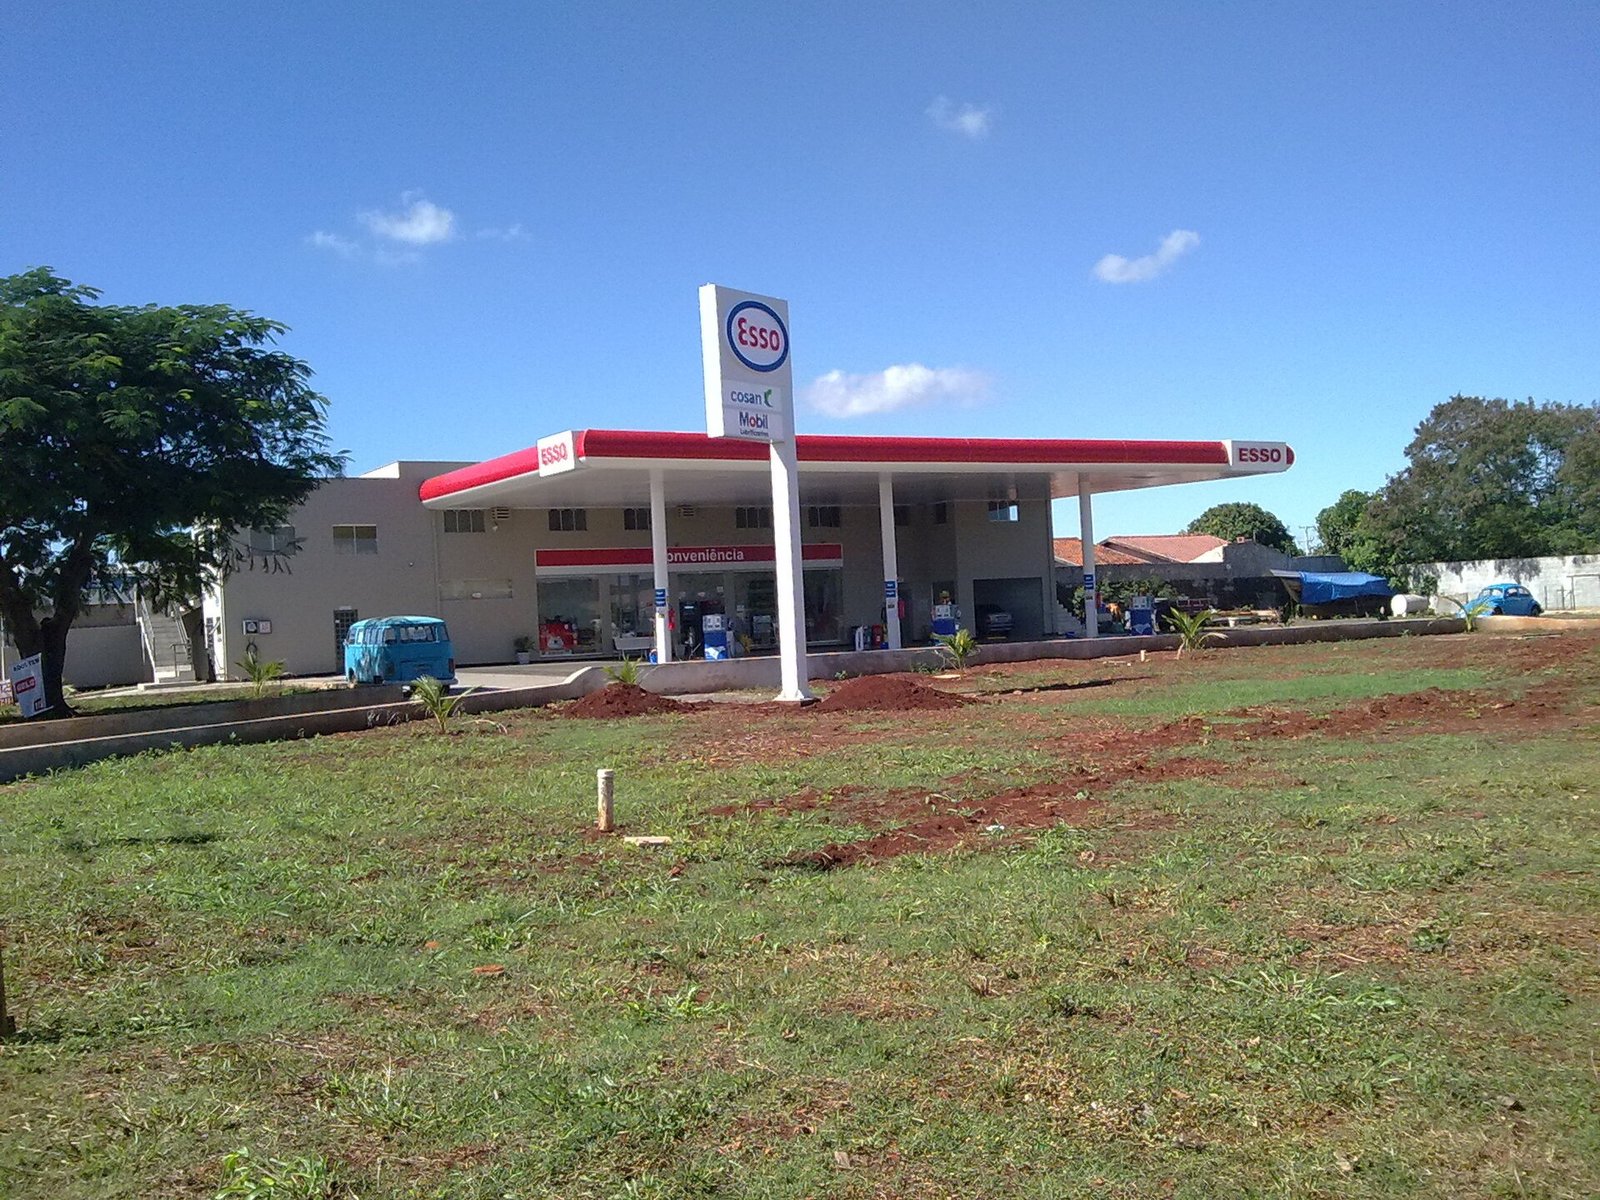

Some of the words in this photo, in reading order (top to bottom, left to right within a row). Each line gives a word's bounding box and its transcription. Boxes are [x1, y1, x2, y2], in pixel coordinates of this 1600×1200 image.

[731, 390, 762, 406] cosan
[739, 411, 769, 430] Mobil
[541, 442, 568, 466] ESSO
[1238, 448, 1281, 463] ESSO
[667, 548, 745, 563] onveniência
